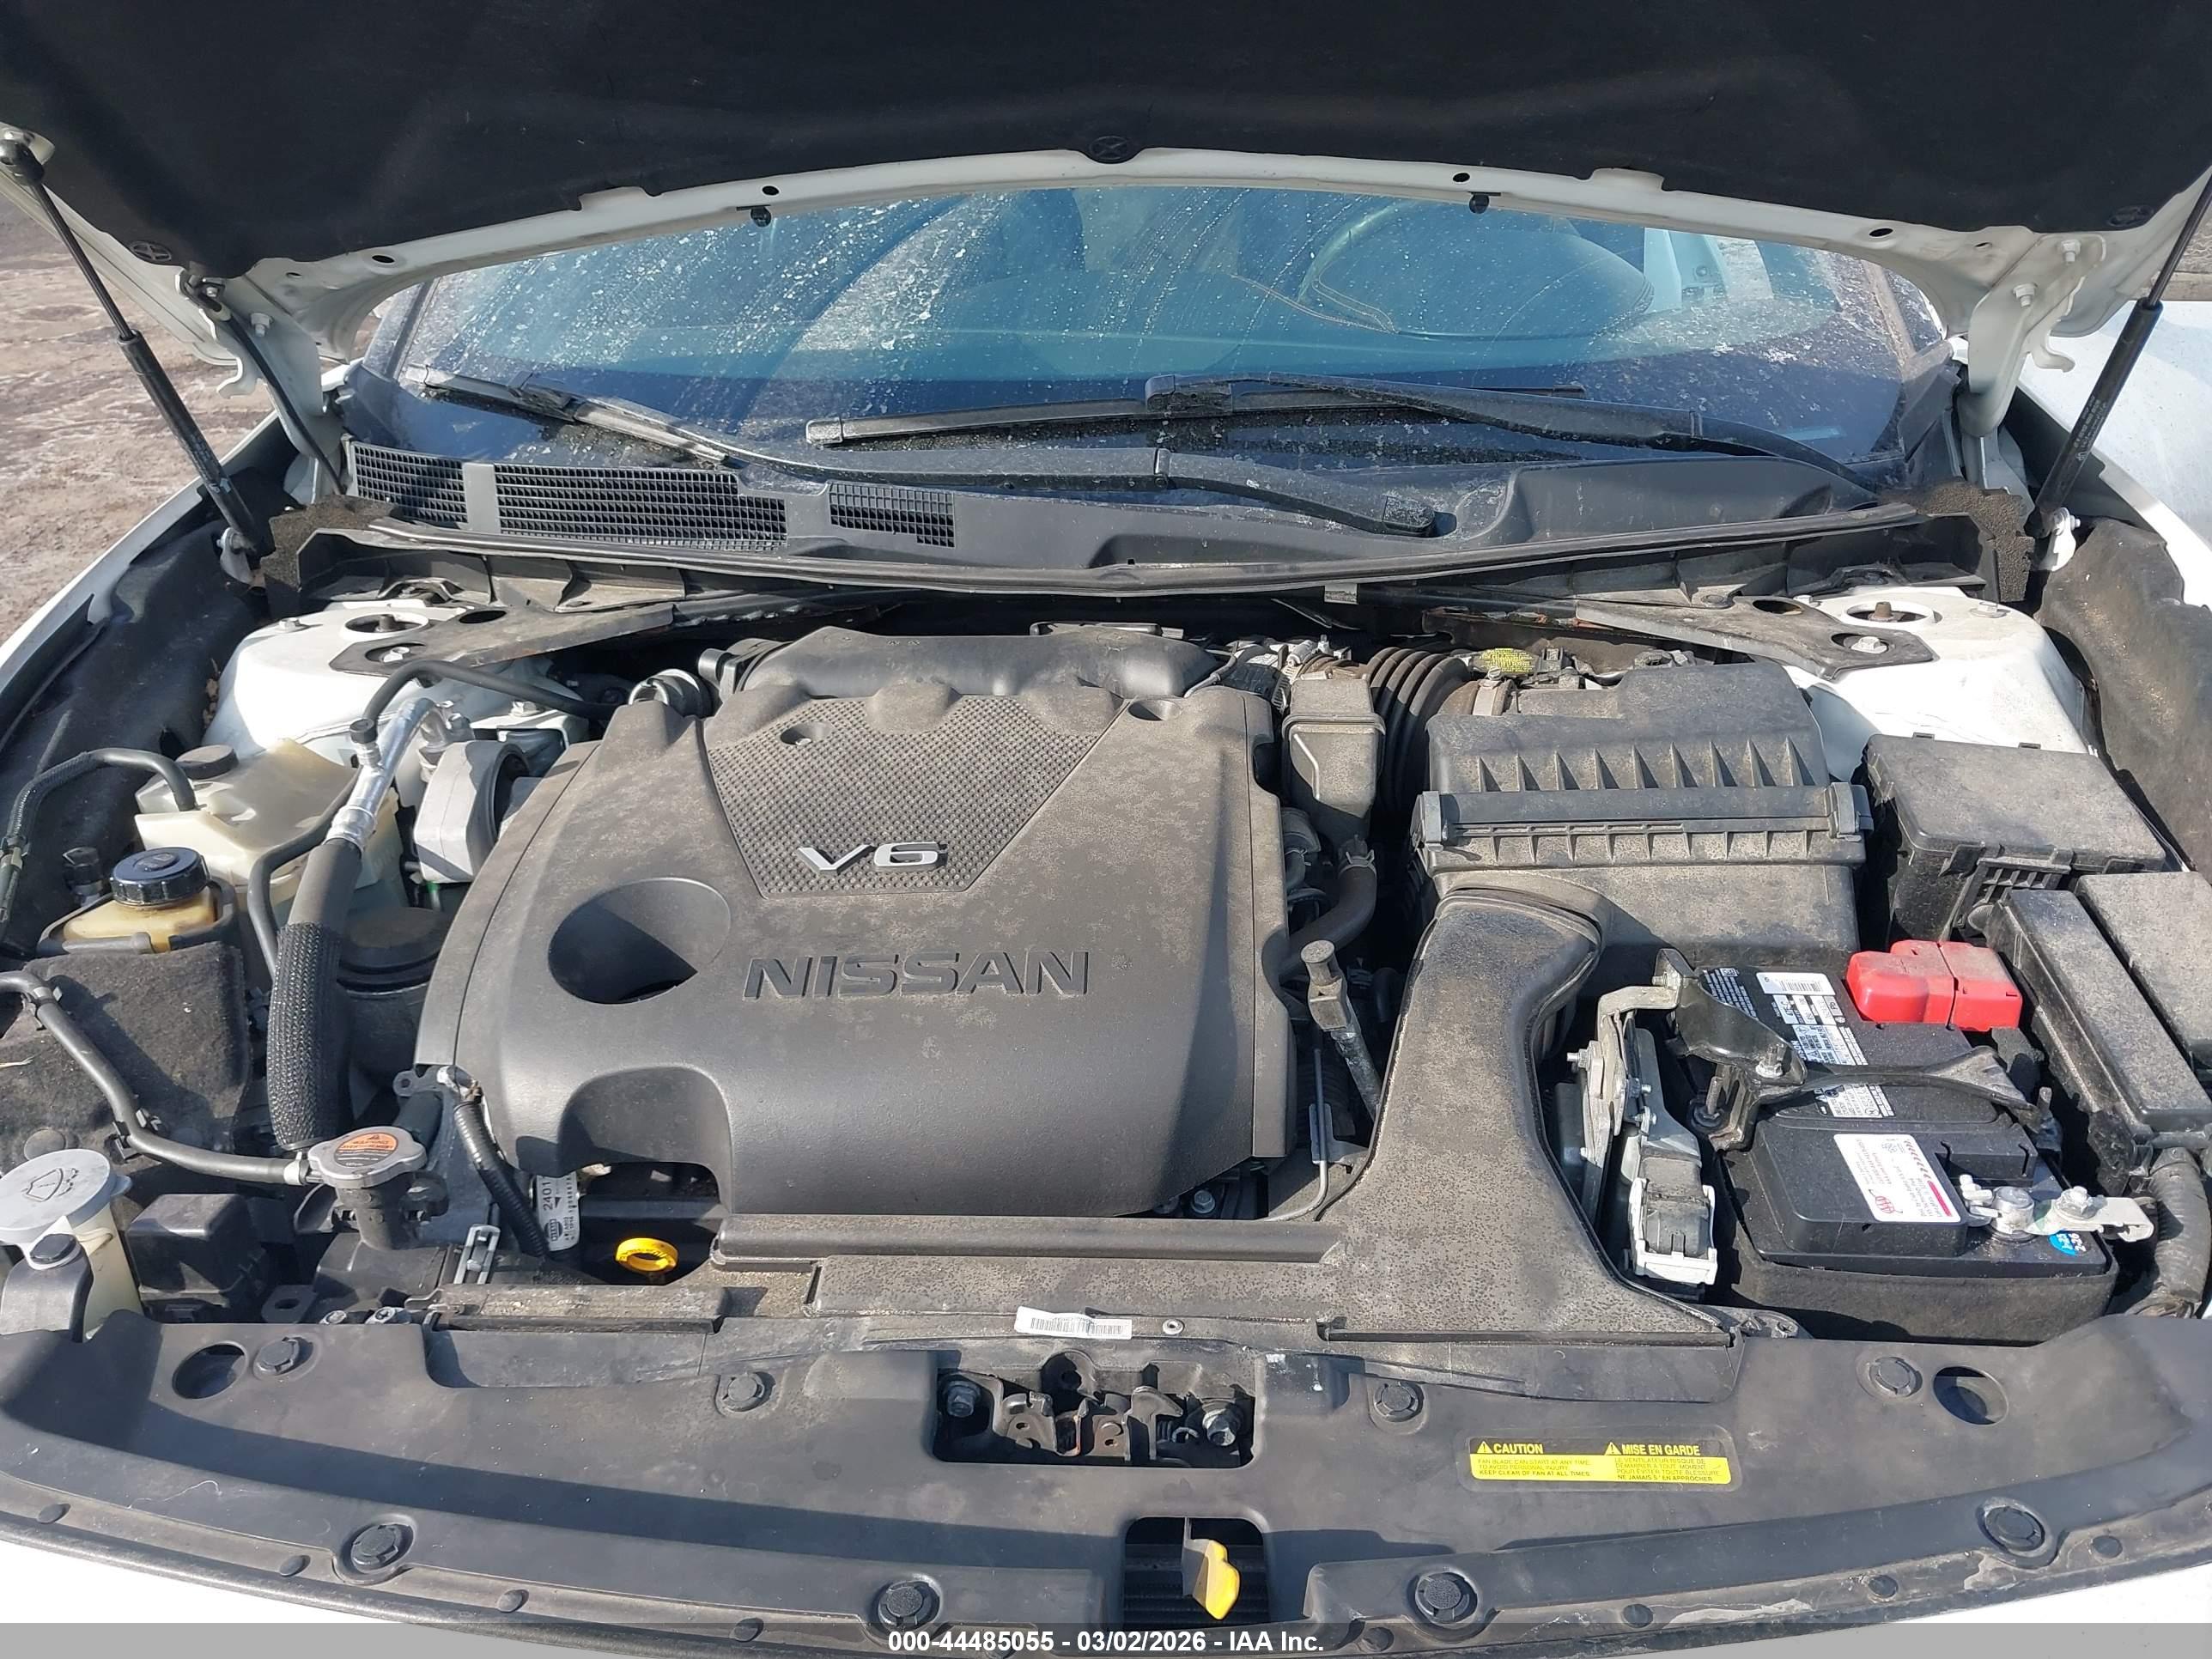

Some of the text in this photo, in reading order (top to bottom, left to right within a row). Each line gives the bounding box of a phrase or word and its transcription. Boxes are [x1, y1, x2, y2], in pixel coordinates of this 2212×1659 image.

[798, 841, 948, 874] V6
[744, 951, 1090, 1000] NISSAN
[543, 1175, 554, 1211] 2401
[1493, 1443, 1544, 1454] CAUTION
[1621, 1443, 1701, 1455] MISE EN GARDE
